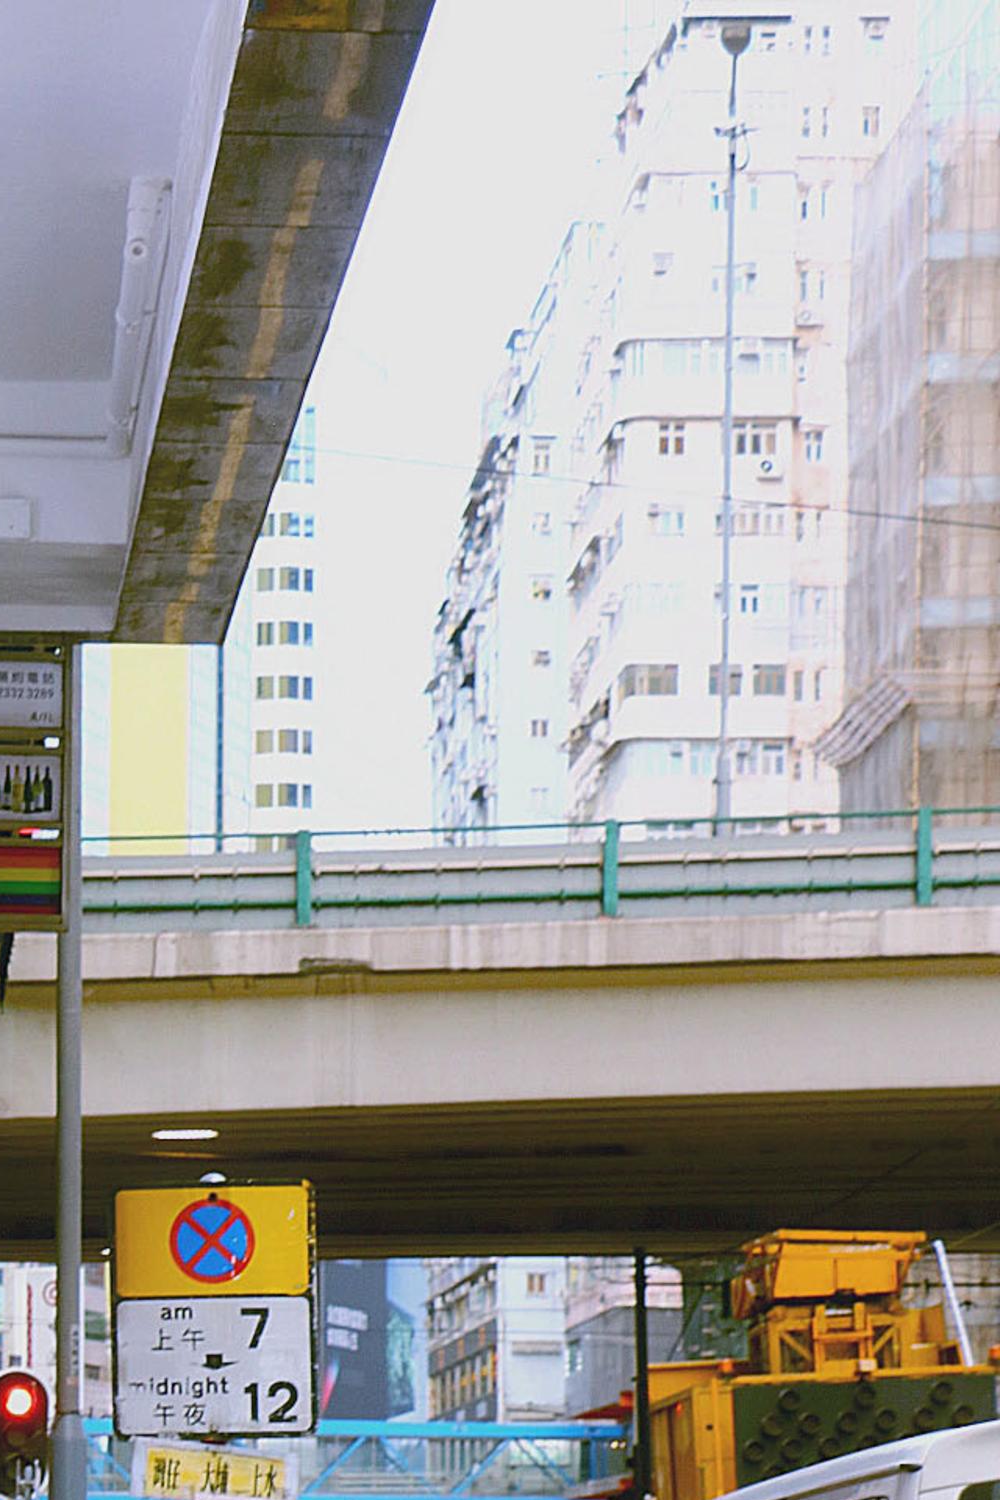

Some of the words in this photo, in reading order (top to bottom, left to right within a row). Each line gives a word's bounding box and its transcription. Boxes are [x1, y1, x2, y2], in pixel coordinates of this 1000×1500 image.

[151, 1329, 205, 1352] 上午
[160, 1305, 194, 1321] am
[240, 1308, 269, 1349] 7
[154, 1403, 206, 1427] 午夜
[244, 1381, 299, 1424] 12
